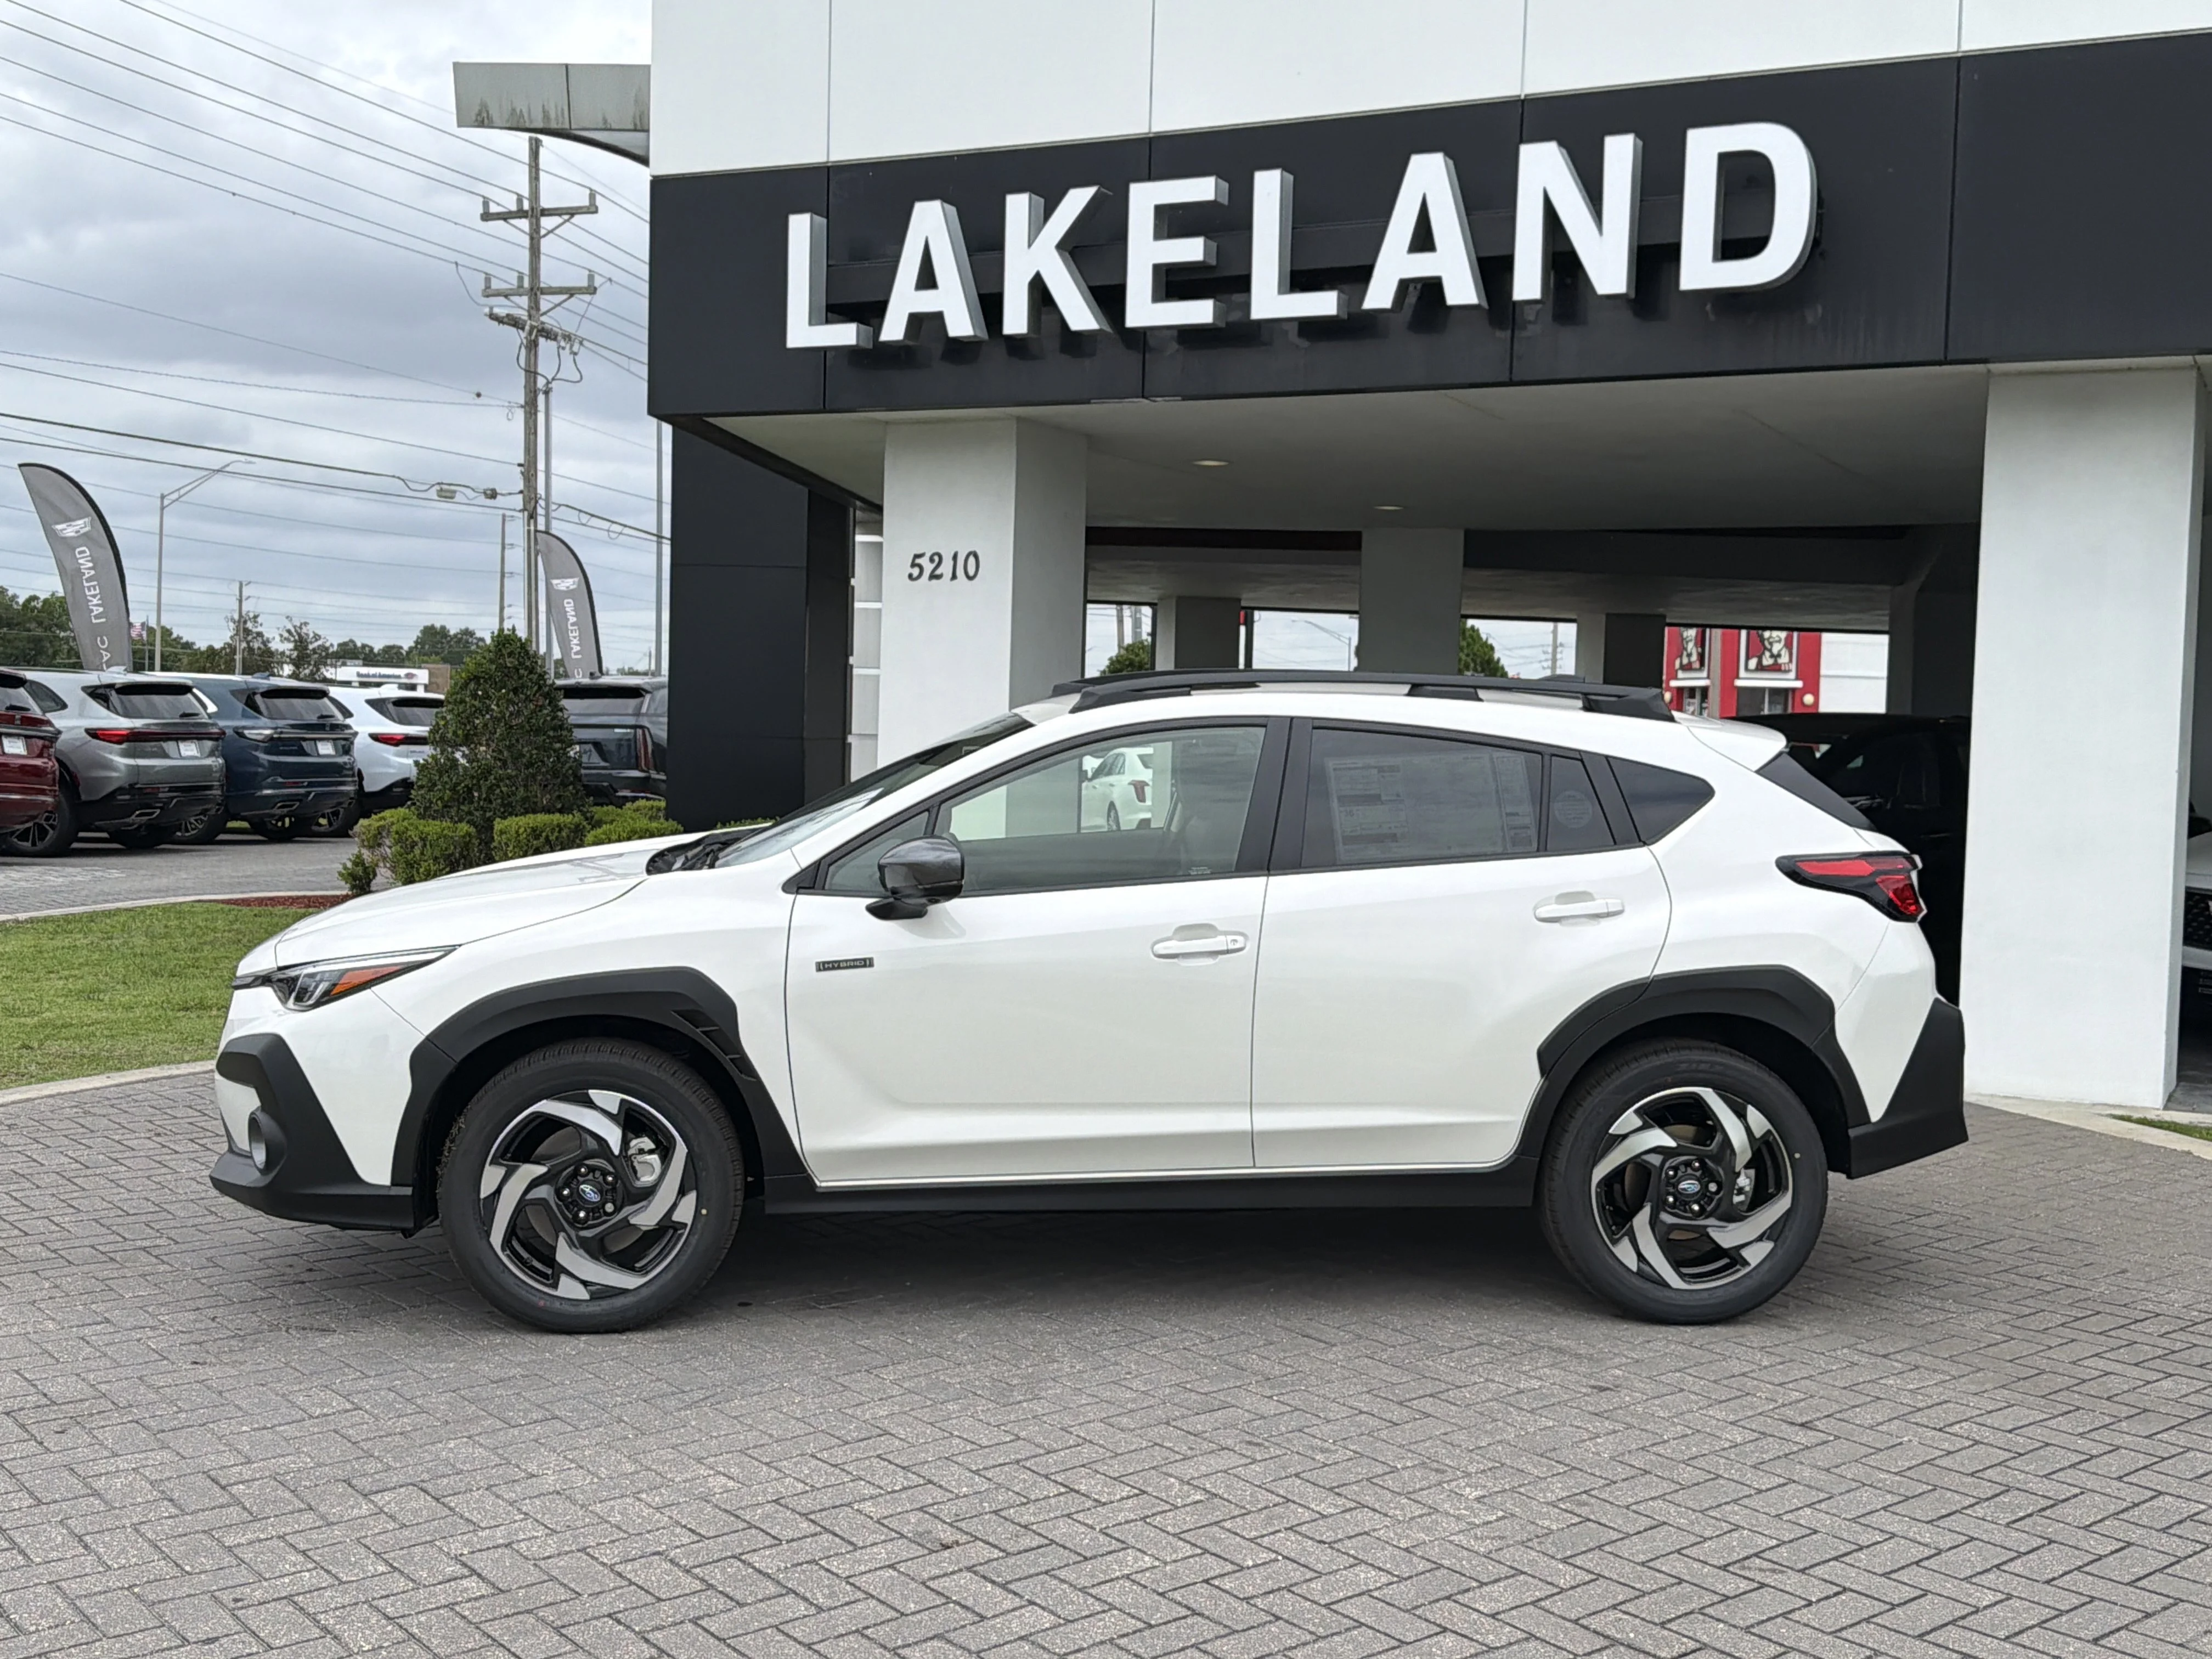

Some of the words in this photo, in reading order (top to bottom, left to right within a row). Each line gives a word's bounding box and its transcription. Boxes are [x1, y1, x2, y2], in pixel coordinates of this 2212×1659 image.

[786, 122, 1815, 349] LAKELAND
[907, 550, 980, 582] 5210
[824, 960, 865, 968] HYBRID
